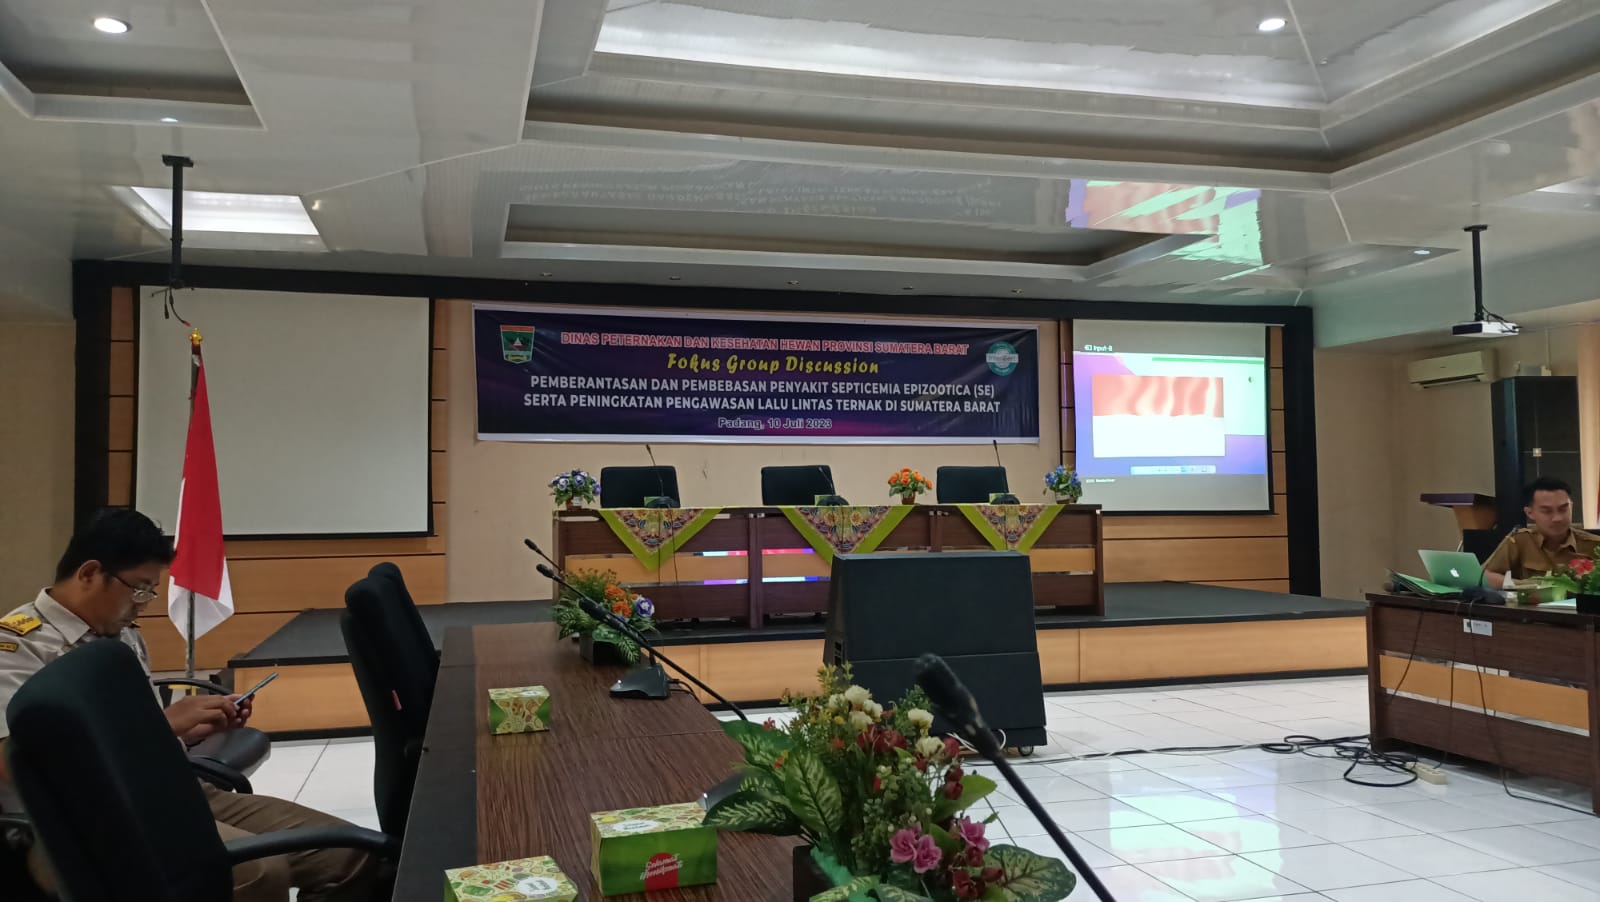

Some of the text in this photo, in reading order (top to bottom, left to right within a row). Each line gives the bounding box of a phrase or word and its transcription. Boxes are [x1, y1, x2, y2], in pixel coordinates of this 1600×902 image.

[561, 332, 969, 355] DINAS PETERNAKAN DAN KESEHATAN HEWAN PROVINSI SUMATERA BARAT
[667, 353, 879, 375] Fokus Group Discussion
[530, 375, 995, 399] PEMBERANTASAN DAN PEMBEBASAN PENYAKIT SEPTICEMIA EPIZOOTICA (SE)
[523, 393, 1000, 413] SERTA PENINGKATAN PENGAWASAN LALU LINTAS TERNAK DI SUMATERA BARAT
[718, 417, 833, 430] Padang, 10 Juli 2023
